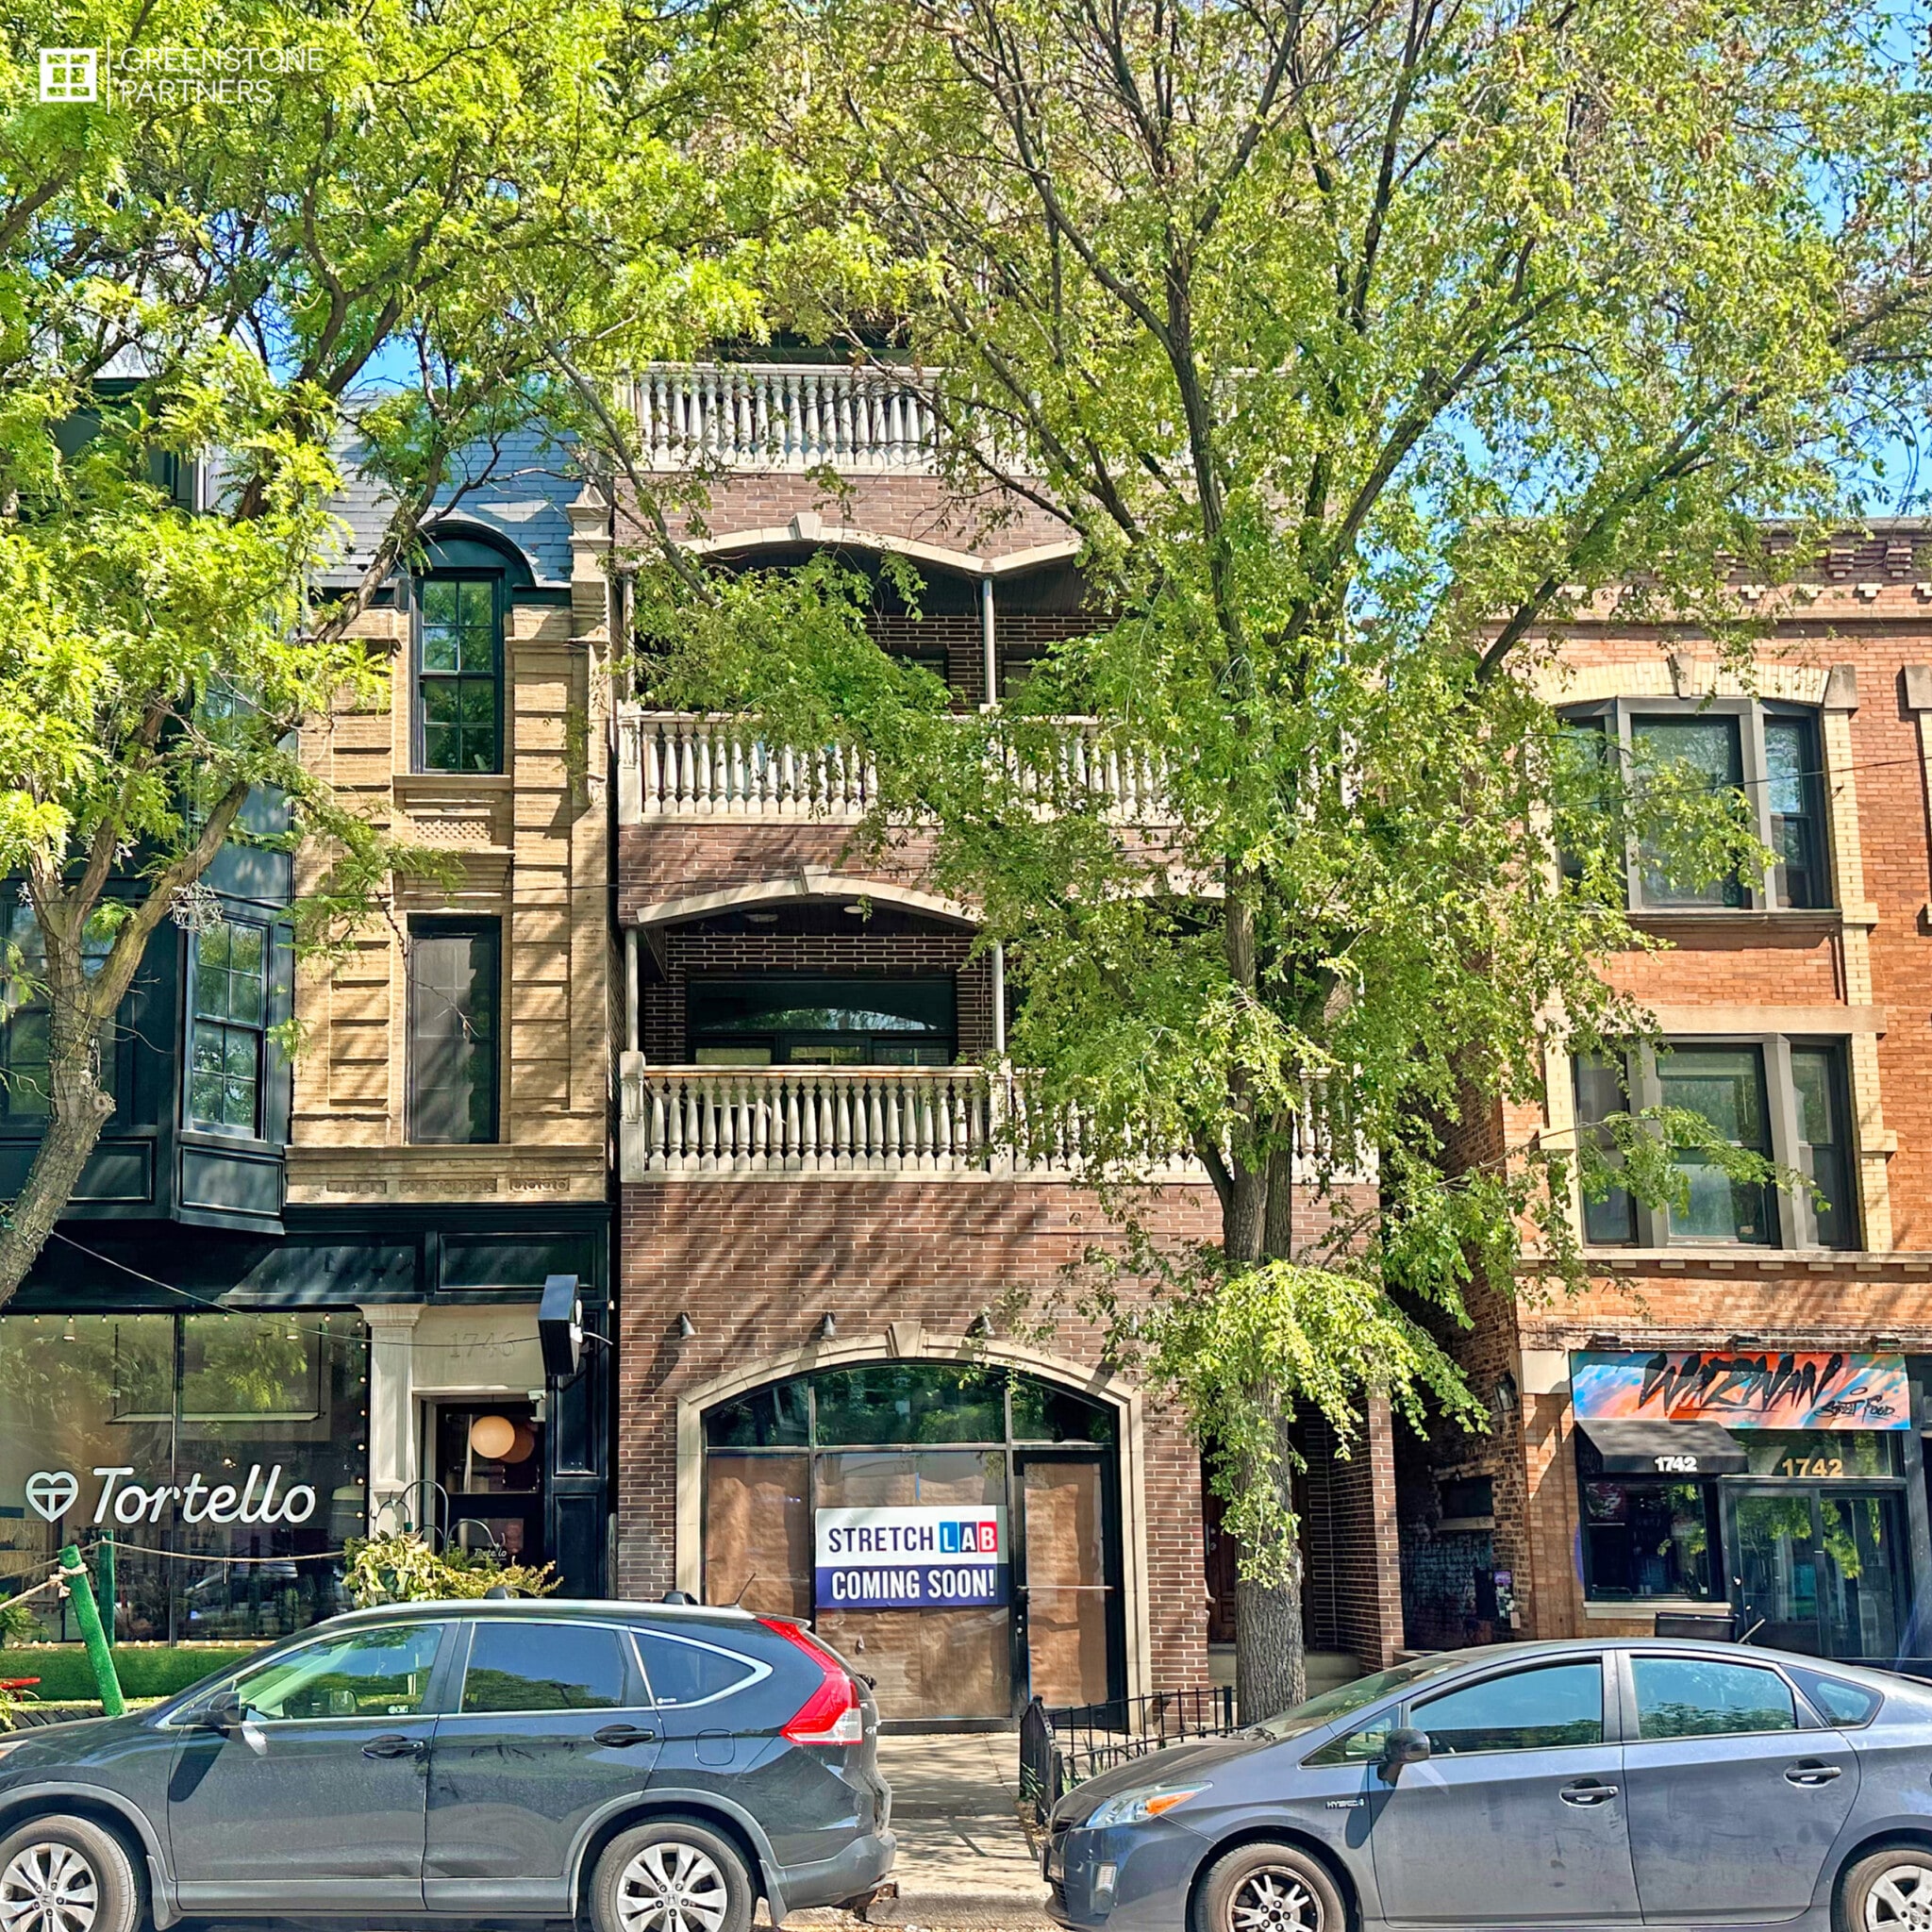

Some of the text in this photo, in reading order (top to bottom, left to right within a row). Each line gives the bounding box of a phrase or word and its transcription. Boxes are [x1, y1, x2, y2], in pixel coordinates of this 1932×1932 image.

[449, 1332, 515, 1358] 1746
[1655, 1457, 1697, 1472] 1742
[1782, 1458, 1843, 1476] 1742
[92, 1464, 316, 1524] Tortello
[828, 1525, 996, 1553] STRETCH LAB
[832, 1569, 995, 1600] COMING SOON!
